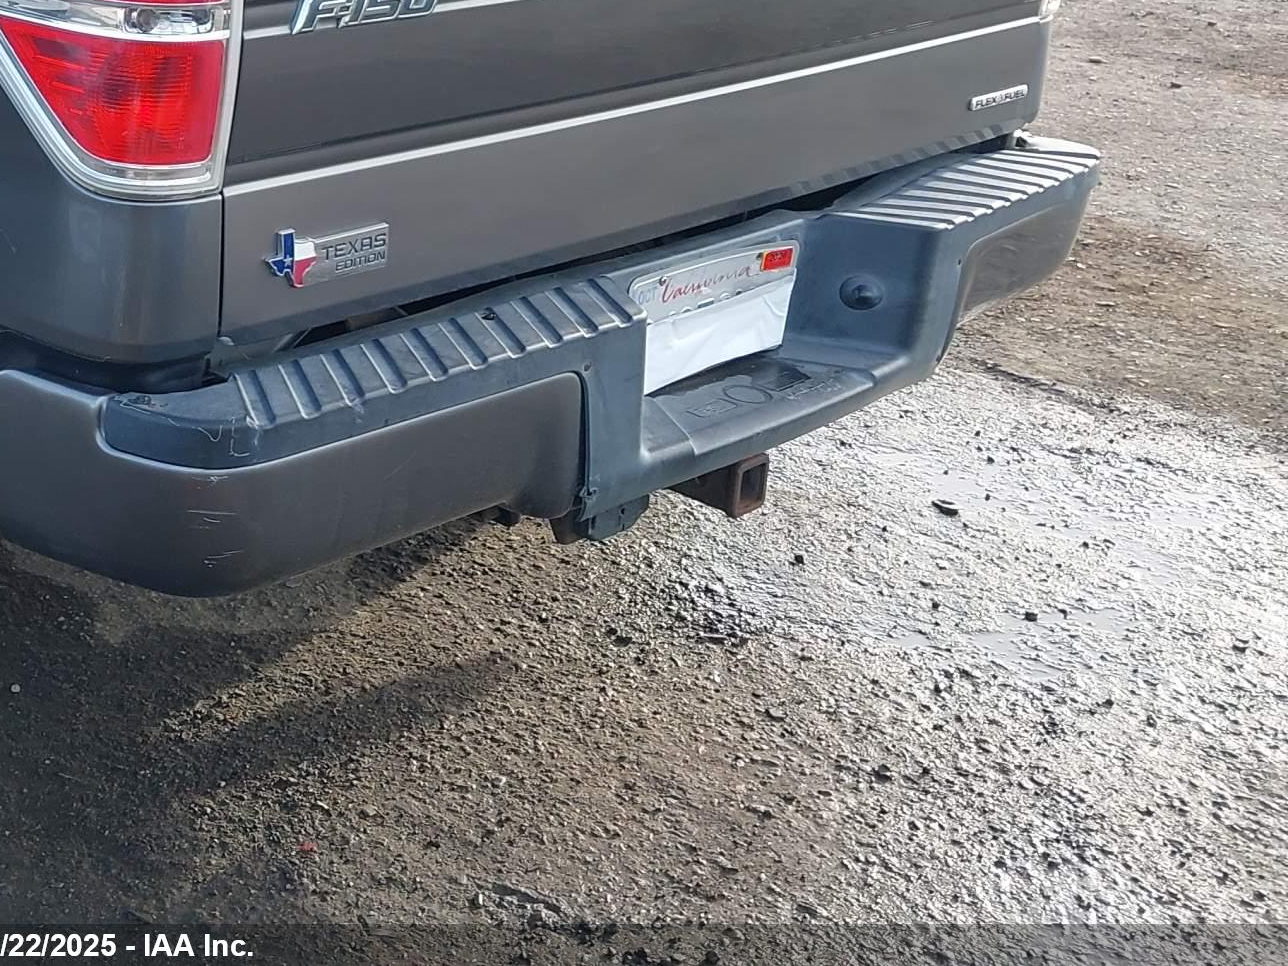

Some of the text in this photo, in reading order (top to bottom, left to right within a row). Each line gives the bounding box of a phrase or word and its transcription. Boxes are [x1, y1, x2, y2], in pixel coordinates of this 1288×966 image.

[975, 89, 1025, 109] FLEX FUEL
[321, 233, 386, 261] TEXAS
[335, 250, 386, 272] EDITION
